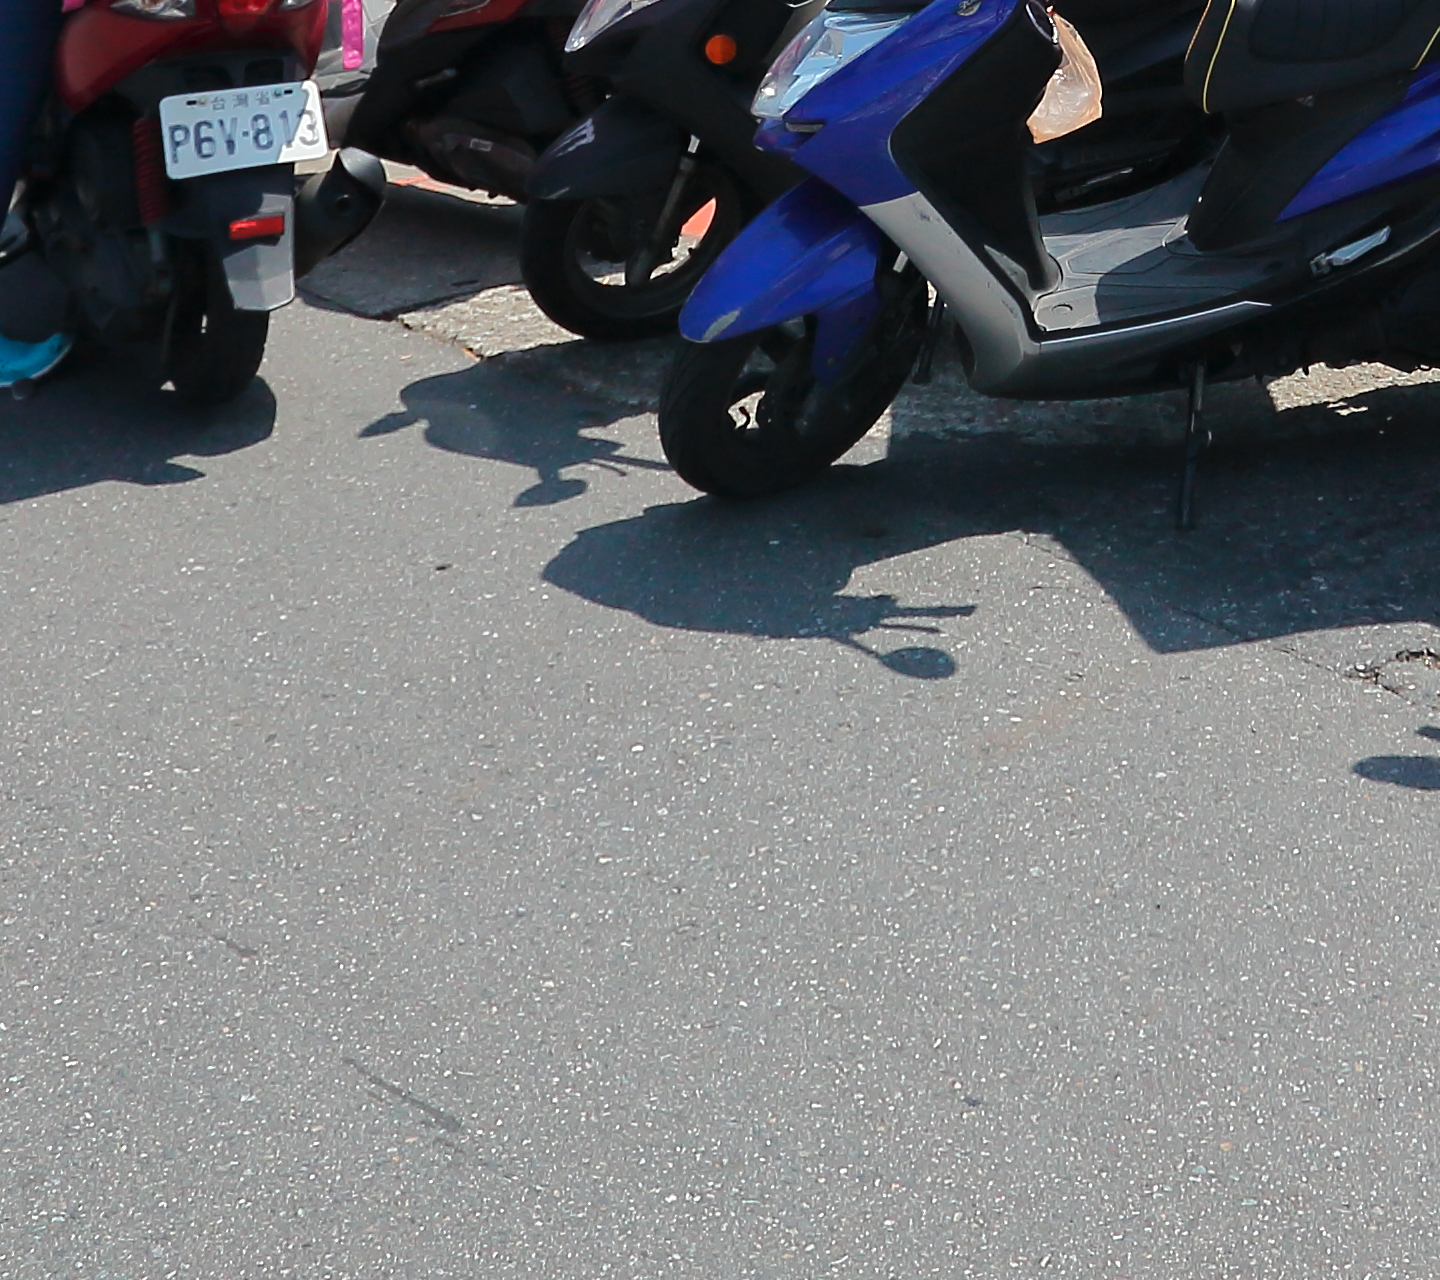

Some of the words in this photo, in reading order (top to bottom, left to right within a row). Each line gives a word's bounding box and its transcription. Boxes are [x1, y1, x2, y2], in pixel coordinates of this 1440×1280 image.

[211, 91, 270, 111] 台灣省
[168, 109, 320, 164] P6V-813
